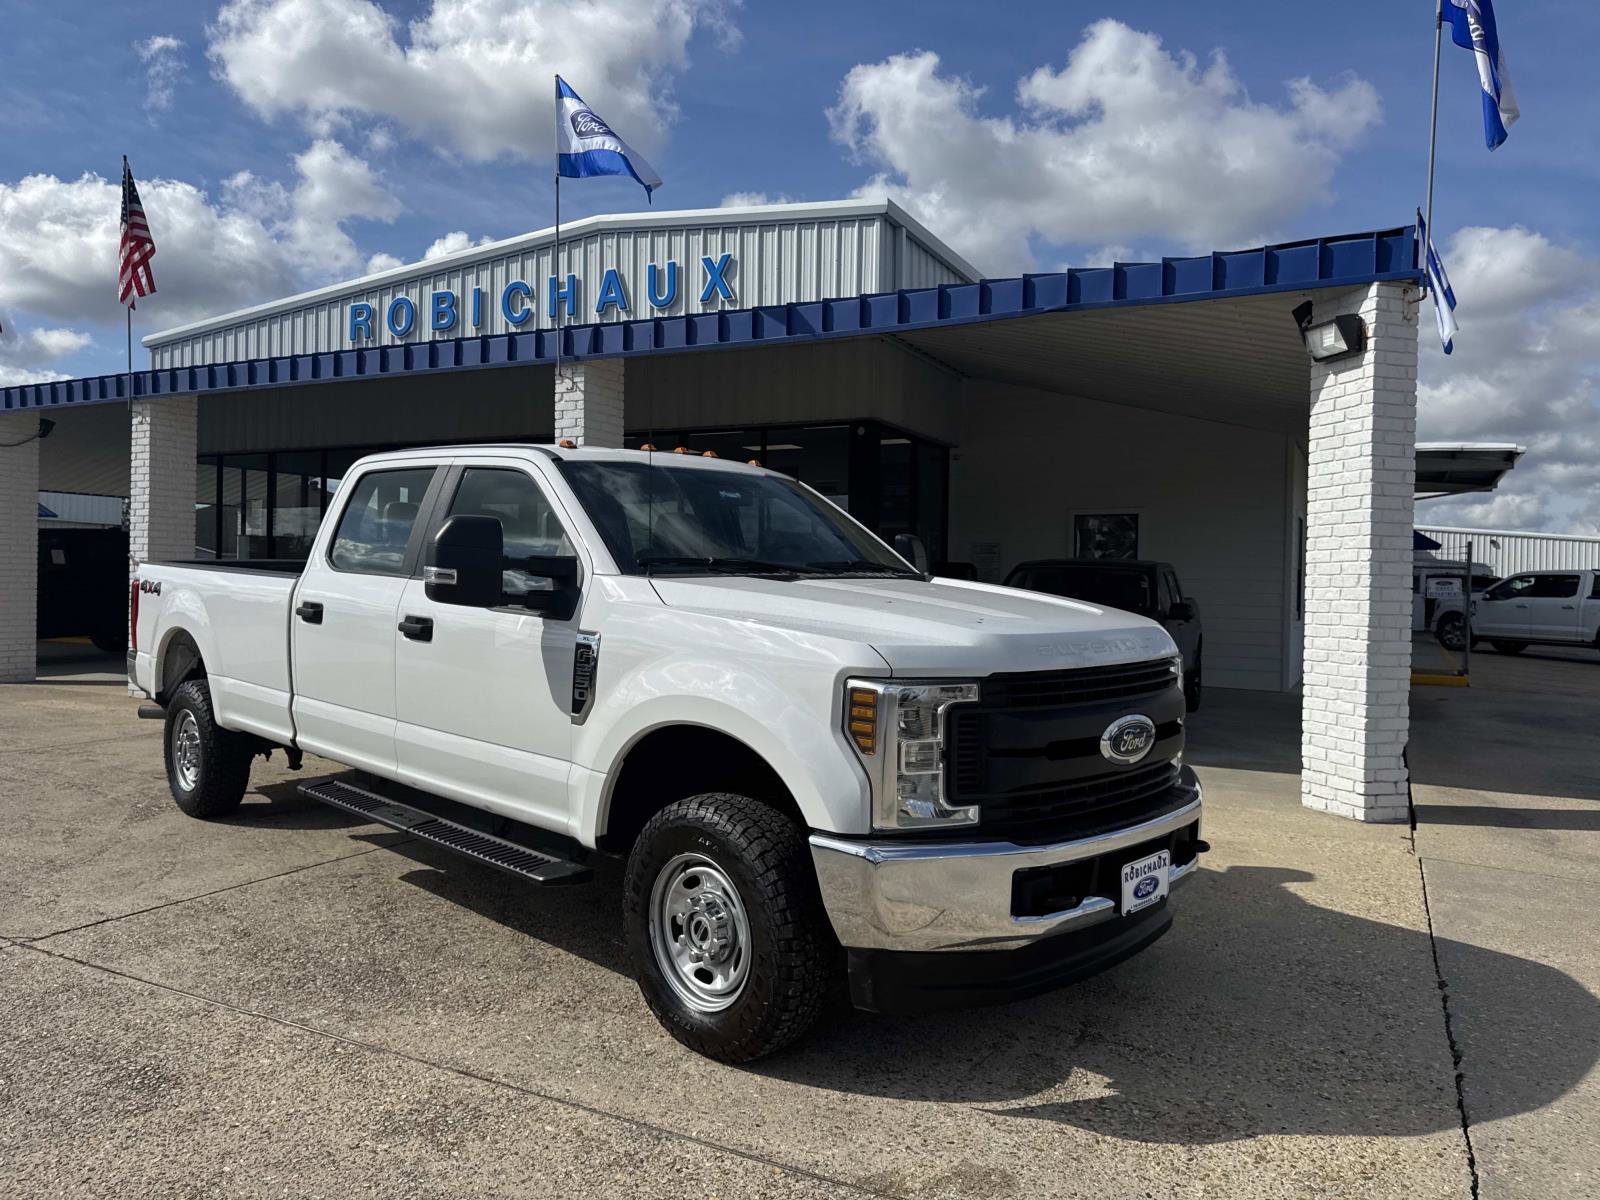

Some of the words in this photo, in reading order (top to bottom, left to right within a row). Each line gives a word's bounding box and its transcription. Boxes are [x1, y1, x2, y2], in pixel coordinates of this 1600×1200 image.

[349, 252, 738, 343] ROBICHAUX
[1120, 728, 1146, 752] Ford
[1124, 856, 1168, 884] ROBICHAUX
[1137, 879, 1156, 897] Ford
